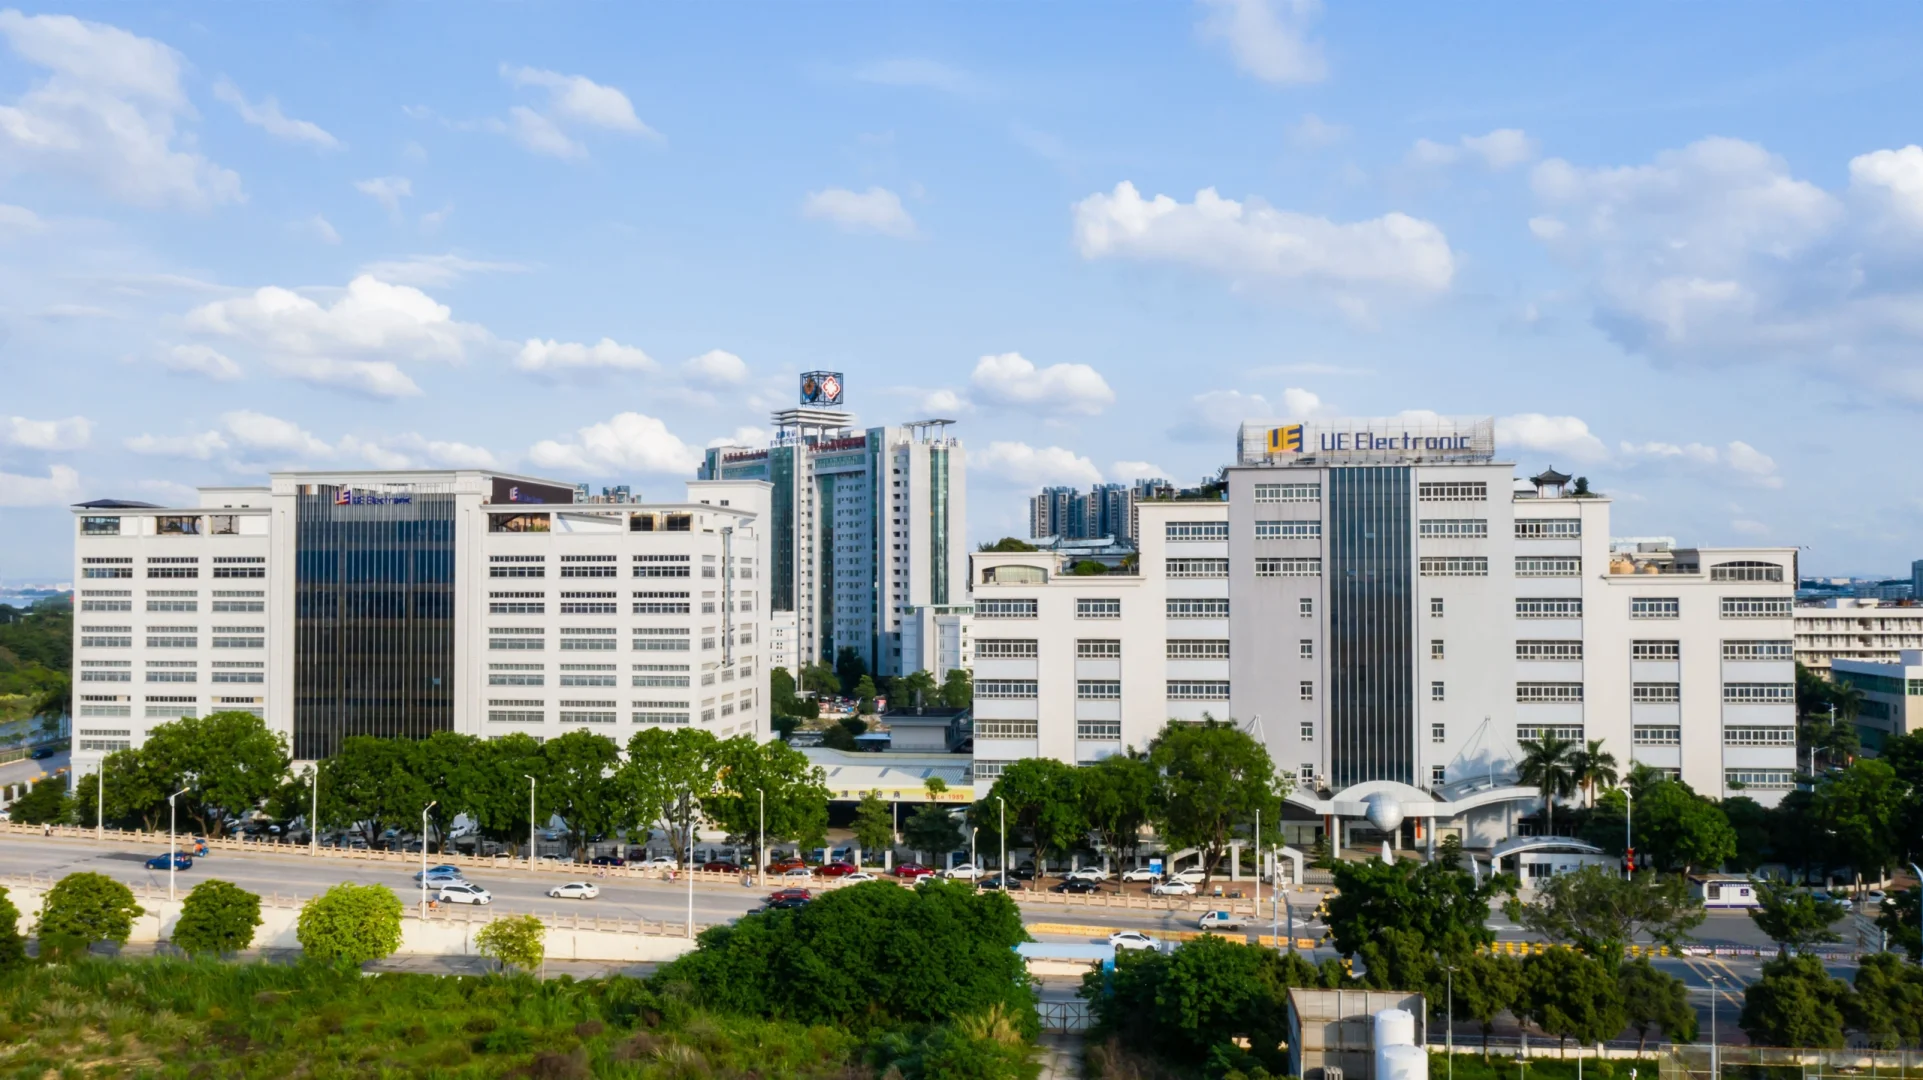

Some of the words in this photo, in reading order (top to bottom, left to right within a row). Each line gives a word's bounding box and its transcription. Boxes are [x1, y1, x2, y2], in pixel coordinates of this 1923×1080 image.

[1267, 424, 1303, 453] UE
[1321, 433, 1349, 451] UE
[1356, 431, 1471, 451] Electronic
[925, 792, 944, 800] Sce
